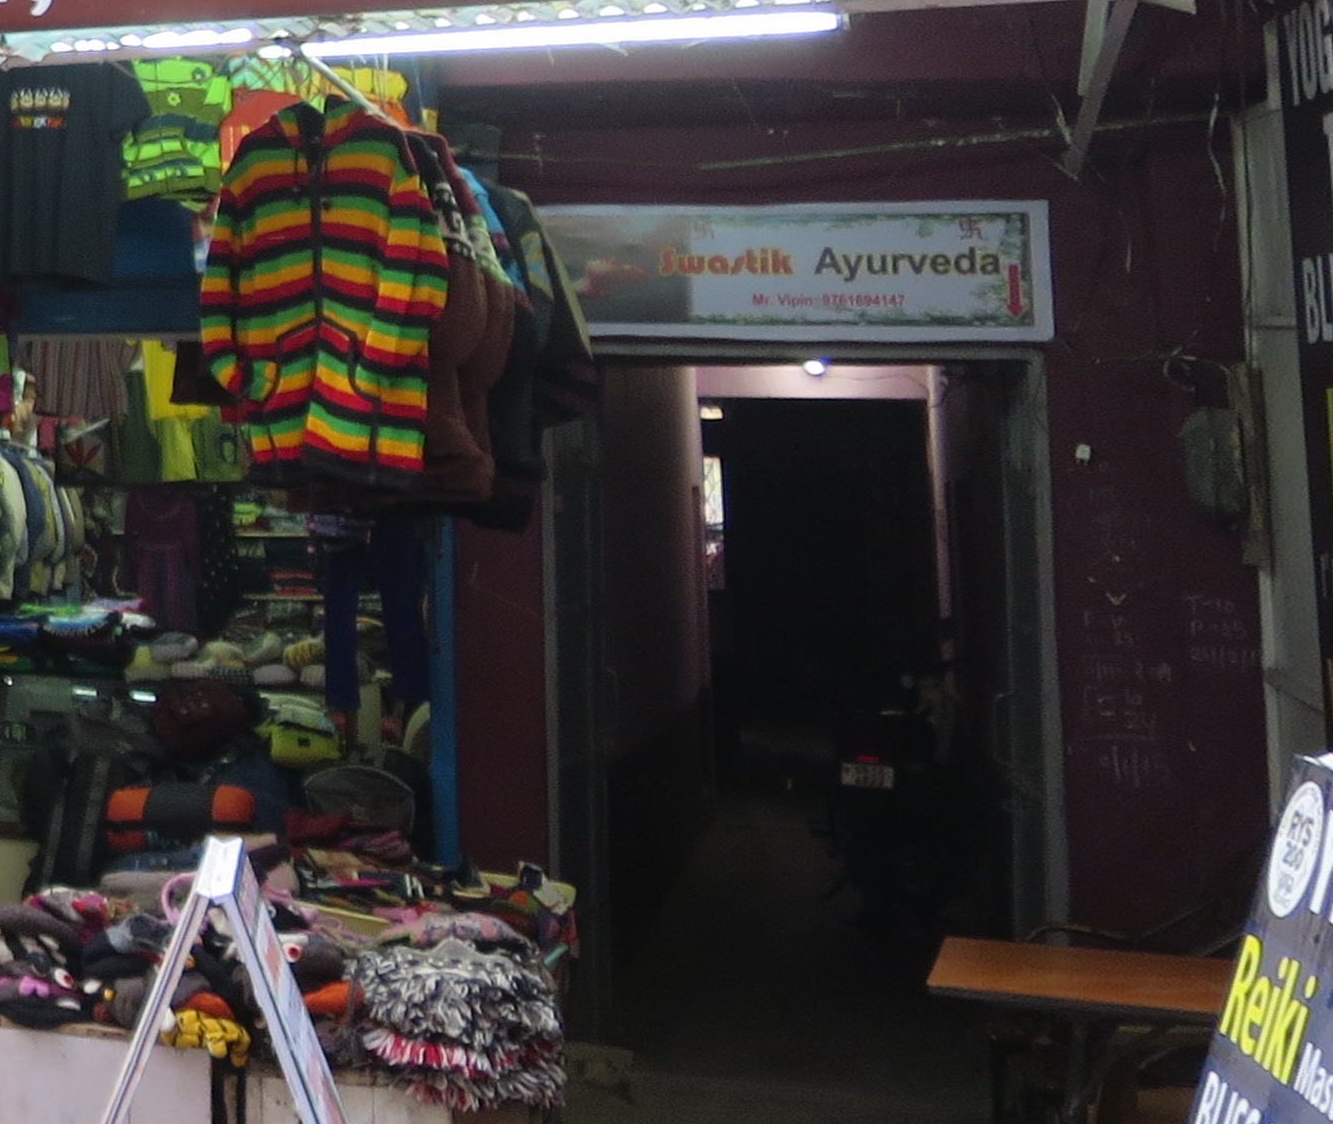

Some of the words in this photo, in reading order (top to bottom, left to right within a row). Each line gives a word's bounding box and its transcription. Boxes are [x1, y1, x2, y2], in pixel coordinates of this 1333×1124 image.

[658, 247, 795, 278] Swastik
[814, 246, 1001, 283] Ayurveda
[1218, 933, 1320, 1086] Reiki
